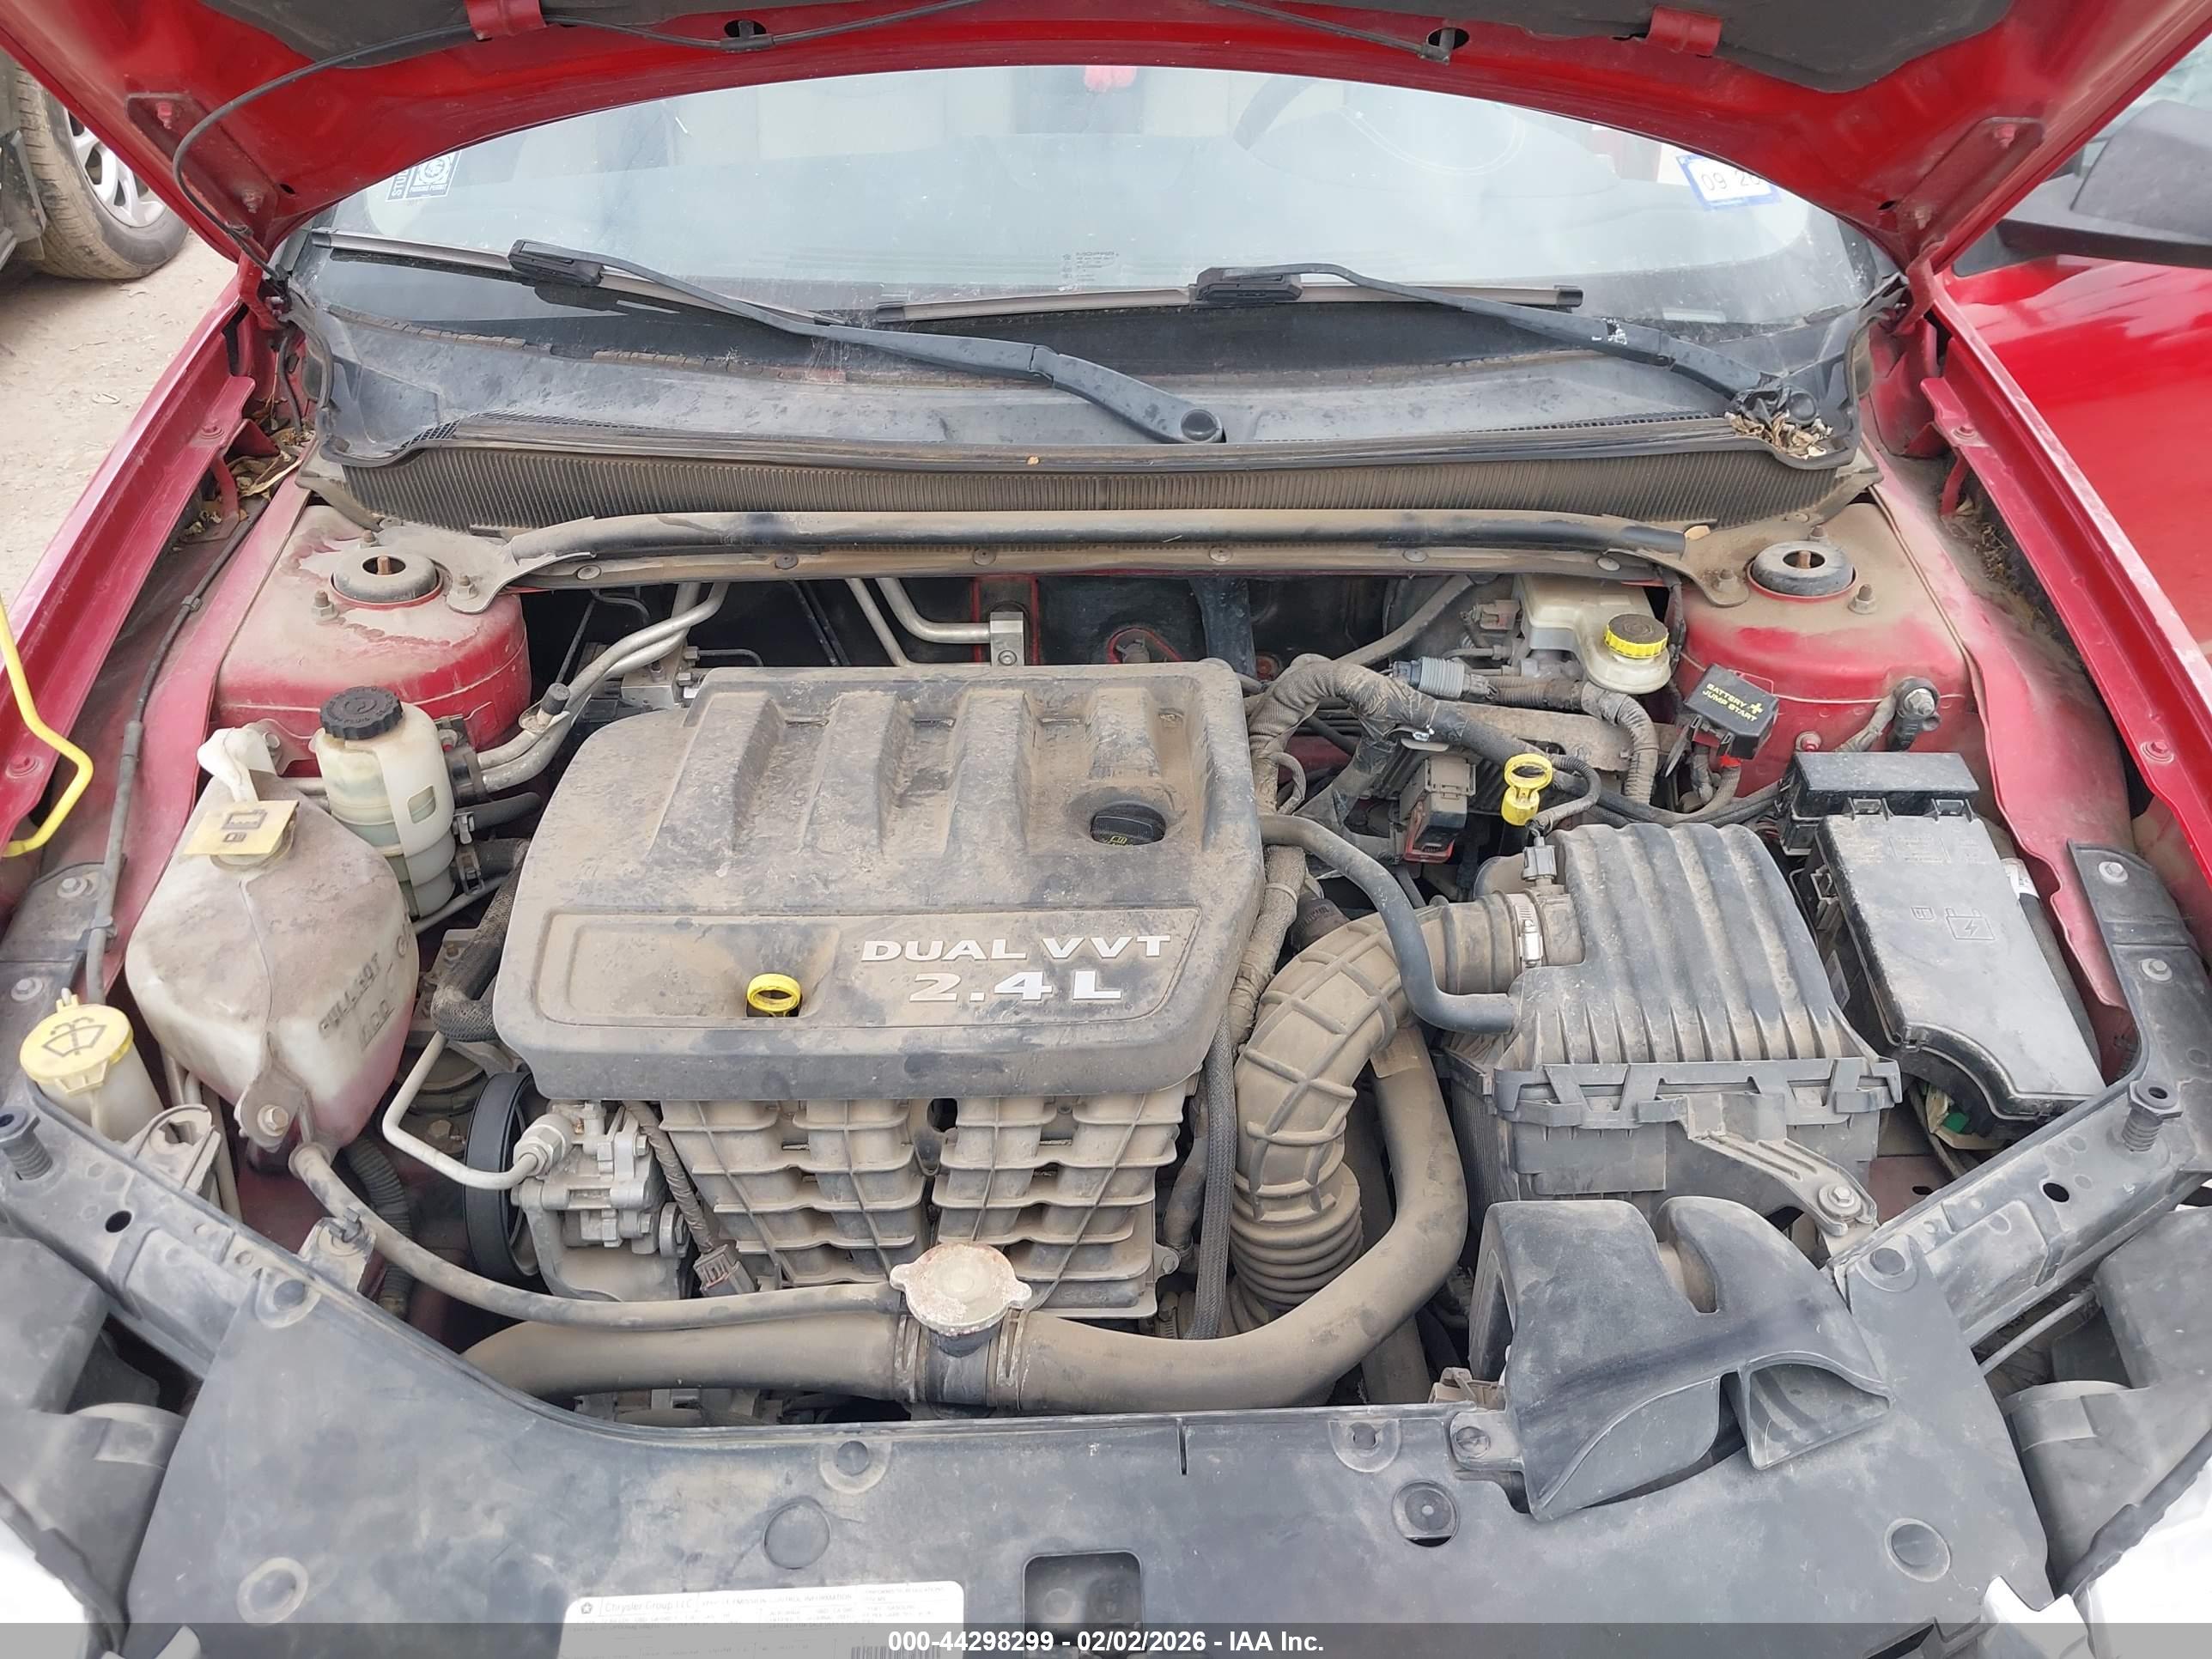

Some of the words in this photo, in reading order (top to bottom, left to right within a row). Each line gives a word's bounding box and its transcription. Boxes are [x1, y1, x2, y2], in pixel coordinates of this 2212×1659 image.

[1702, 690, 1728, 705] JUMP
[1728, 703, 1758, 721] START
[1706, 683, 1747, 708] BATTERY
[861, 939, 1026, 962] DUAL
[1042, 935, 1170, 958] VVT
[605, 1601, 642, 1613] Chrysler
[645, 1600, 672, 1611] Group
